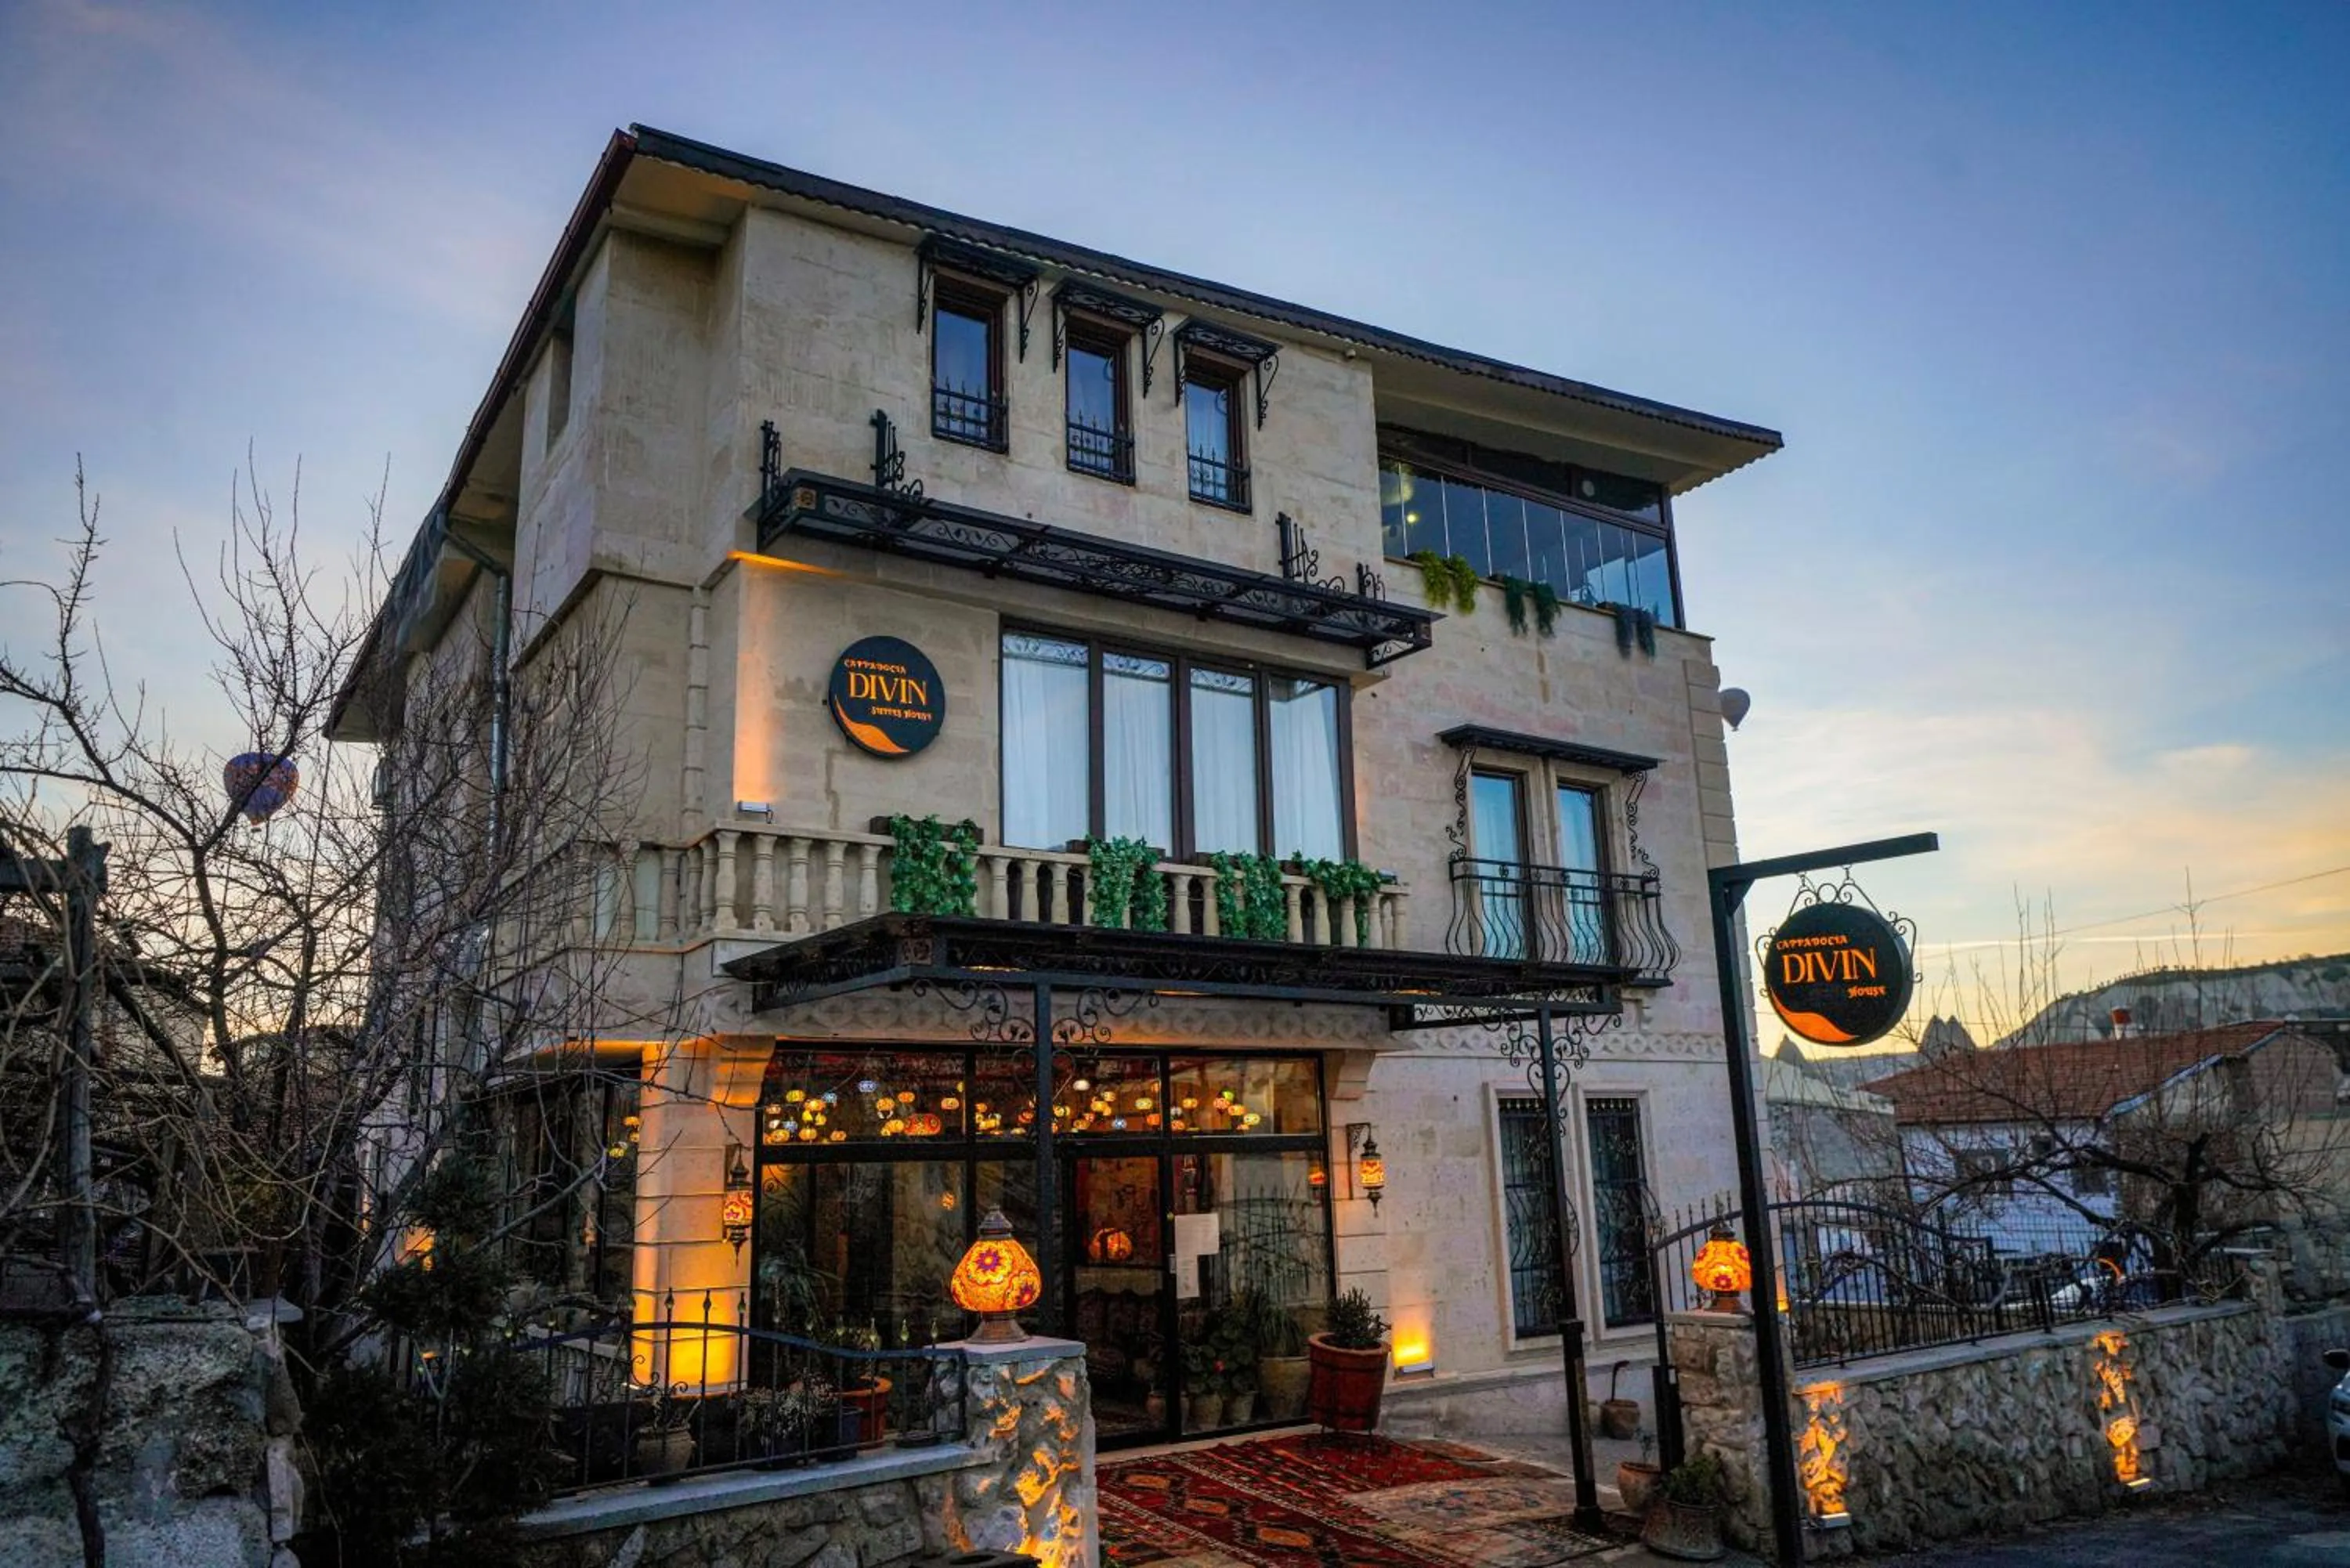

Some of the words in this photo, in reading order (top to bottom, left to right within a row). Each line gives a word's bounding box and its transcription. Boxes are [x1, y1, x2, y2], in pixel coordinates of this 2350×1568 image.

[850, 671, 927, 706] DIVIN
[1776, 934, 1848, 949] CAPPADOCIA
[1782, 947, 1876, 984] DIVIN
